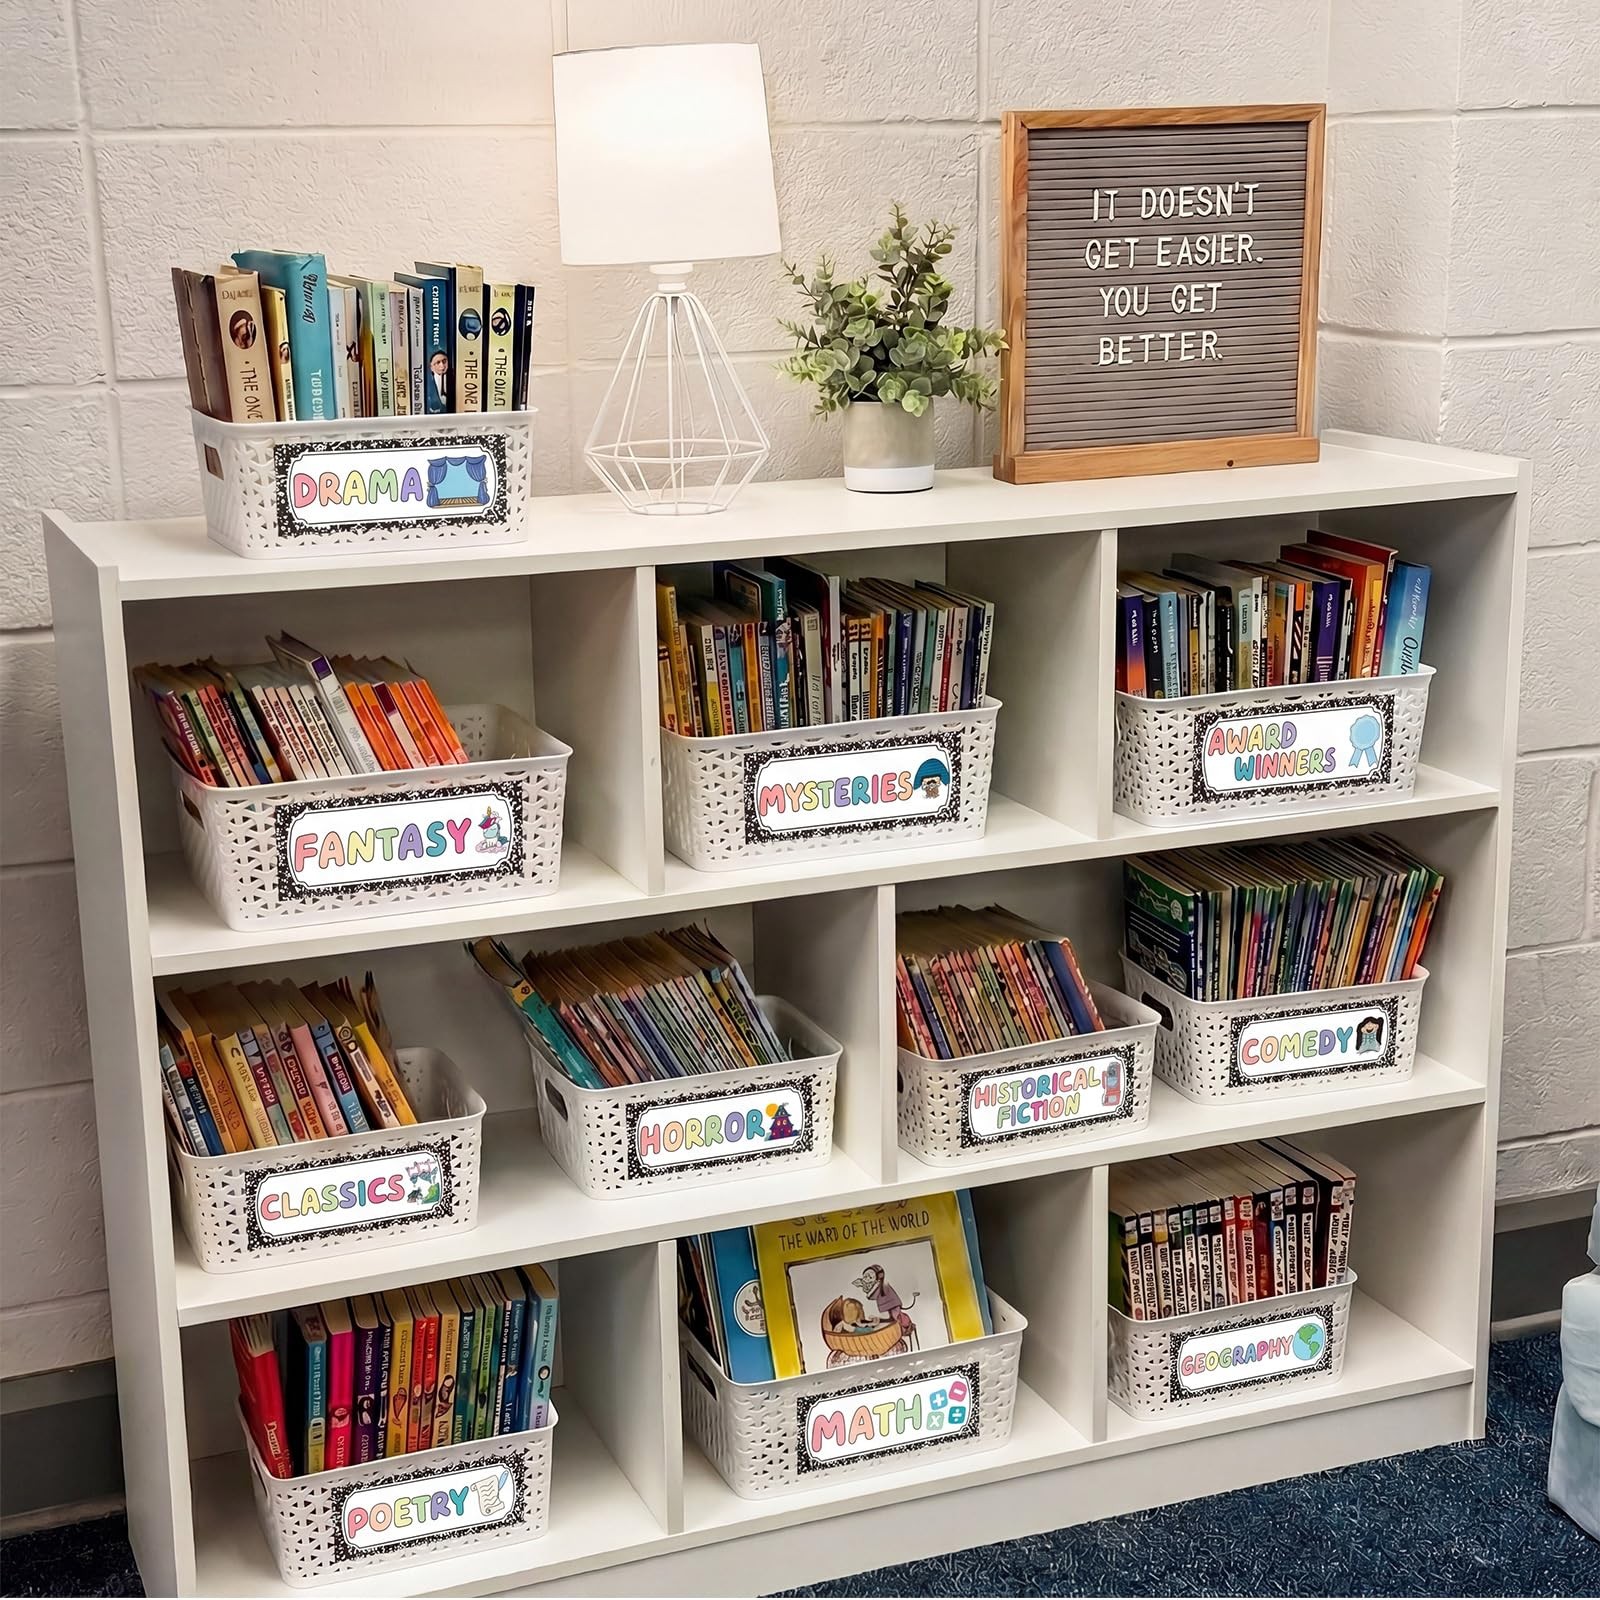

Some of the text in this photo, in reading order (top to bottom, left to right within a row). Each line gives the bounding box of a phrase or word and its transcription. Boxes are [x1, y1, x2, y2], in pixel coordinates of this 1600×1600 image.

[1091, 181, 1260, 222] IT DOESN'T
[1084, 233, 1264, 270] GET EASIER.
[1099, 282, 1223, 318] YOU GET
[1097, 330, 1223, 366] BETTER.
[293, 466, 425, 508] DRAMA
[1207, 720, 1297, 757] AWARD
[1233, 747, 1336, 782] WINNERS
[758, 771, 914, 817] MYSTERIES
[295, 817, 472, 873] FANTASY
[1241, 1026, 1354, 1066] COMEDY
[974, 1066, 1101, 1109] HISTORICAL
[996, 1092, 1081, 1129] FICTION
[639, 1108, 766, 1157] HORROR
[260, 1173, 406, 1221] CLASSICS
[778, 1232, 803, 1252] THE
[842, 1221, 858, 1240] OF
[859, 1219, 887, 1236] THE
[888, 1210, 930, 1231] WORLD
[1180, 1334, 1294, 1377] GEOGRAPHY
[810, 1393, 924, 1454] MATH
[346, 1484, 471, 1539] POETRY
